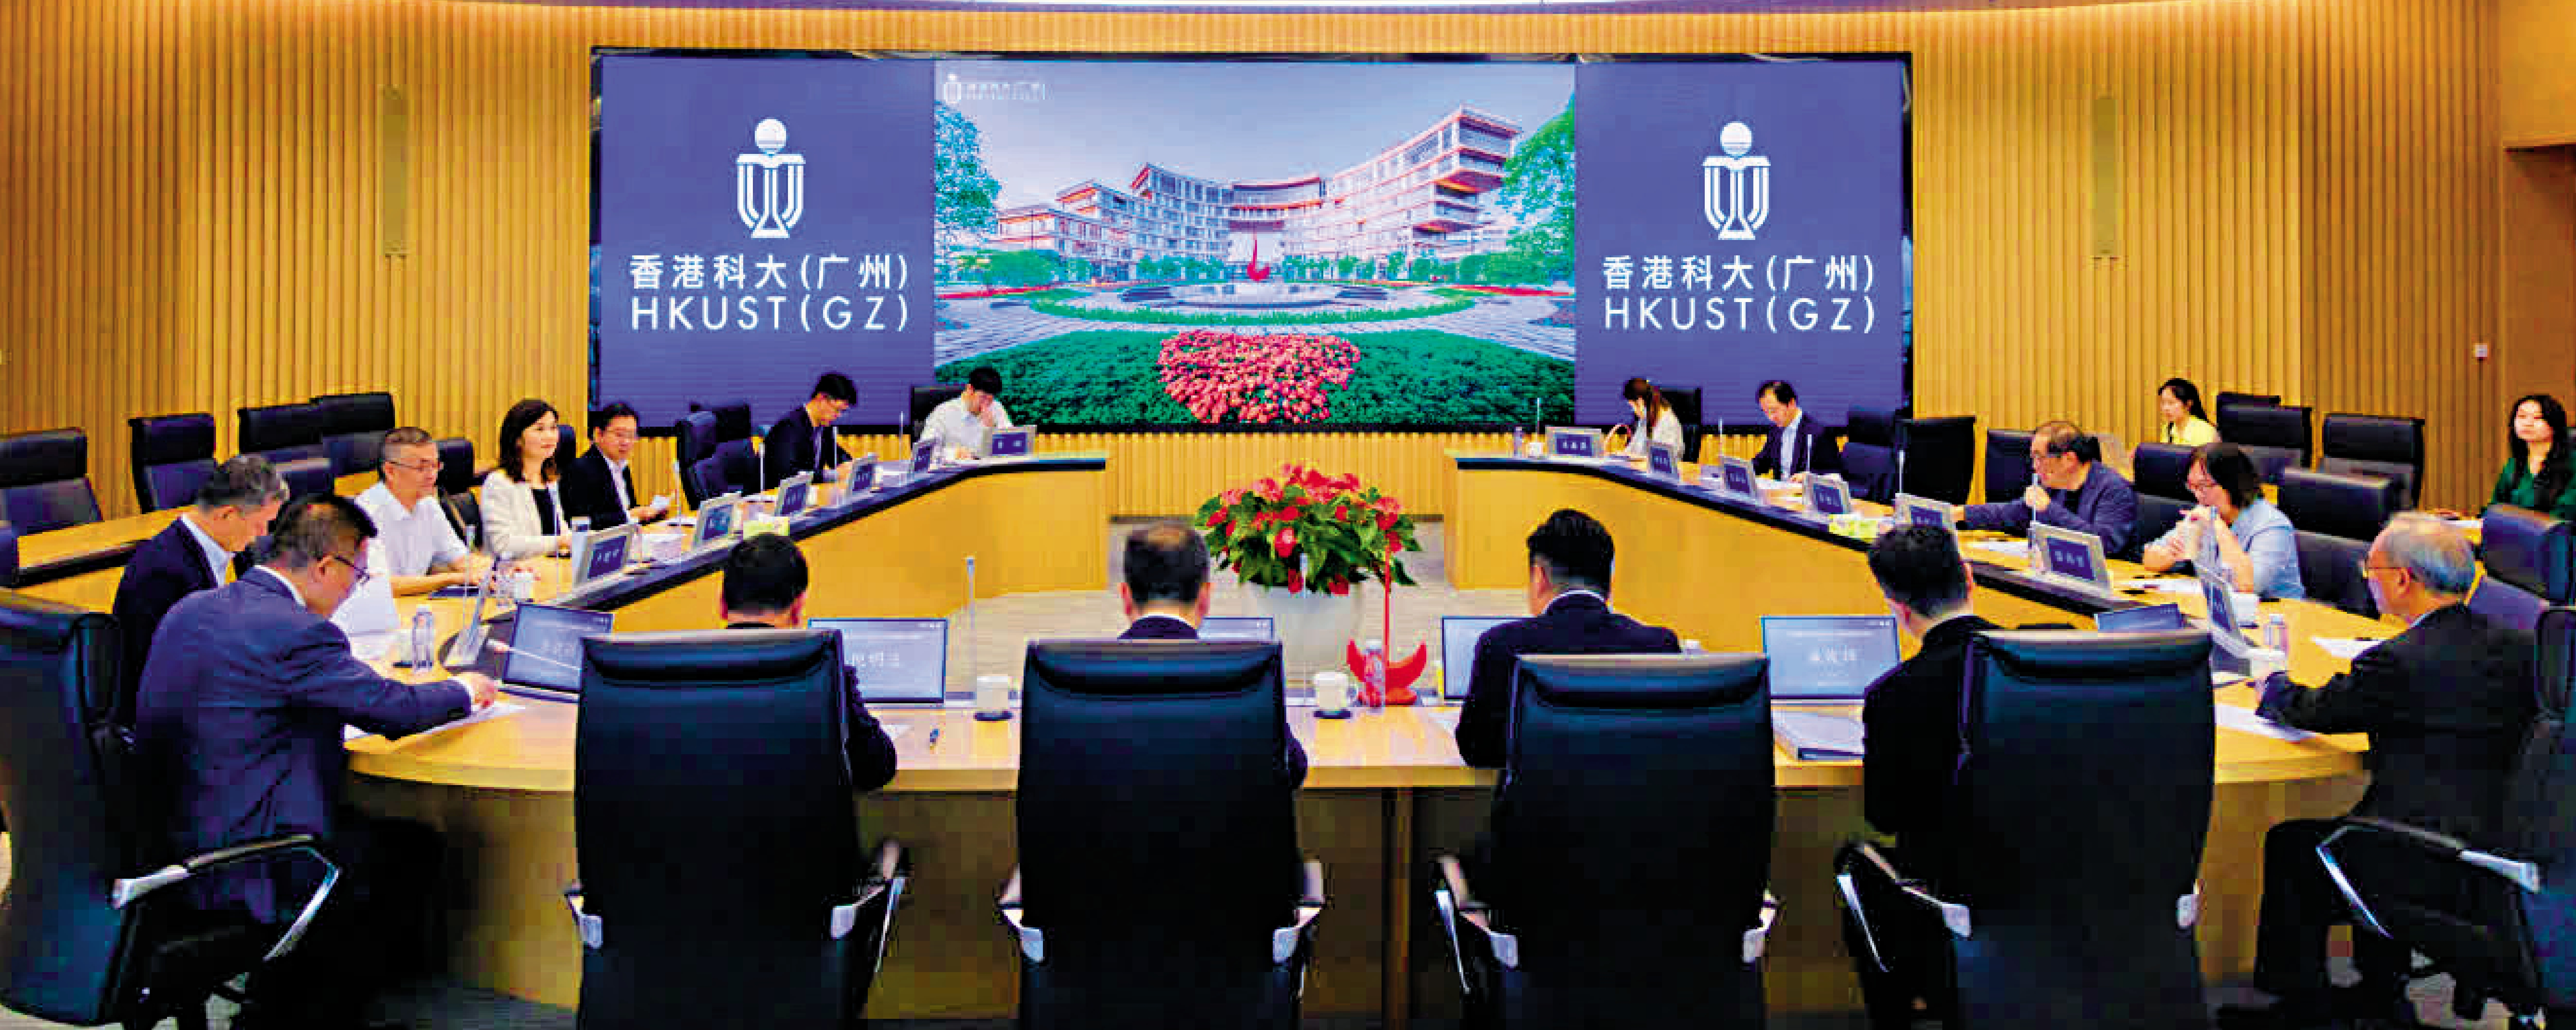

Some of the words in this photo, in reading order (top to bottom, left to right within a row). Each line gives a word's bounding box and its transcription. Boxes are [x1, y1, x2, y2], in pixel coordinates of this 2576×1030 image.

[630, 254, 907, 290] 香港科大(广州)
[1603, 255, 1874, 291] 香港科大(广州)
[631, 295, 907, 332] HKUST(GZ)
[1605, 296, 1874, 333] HKUST(GZ)
